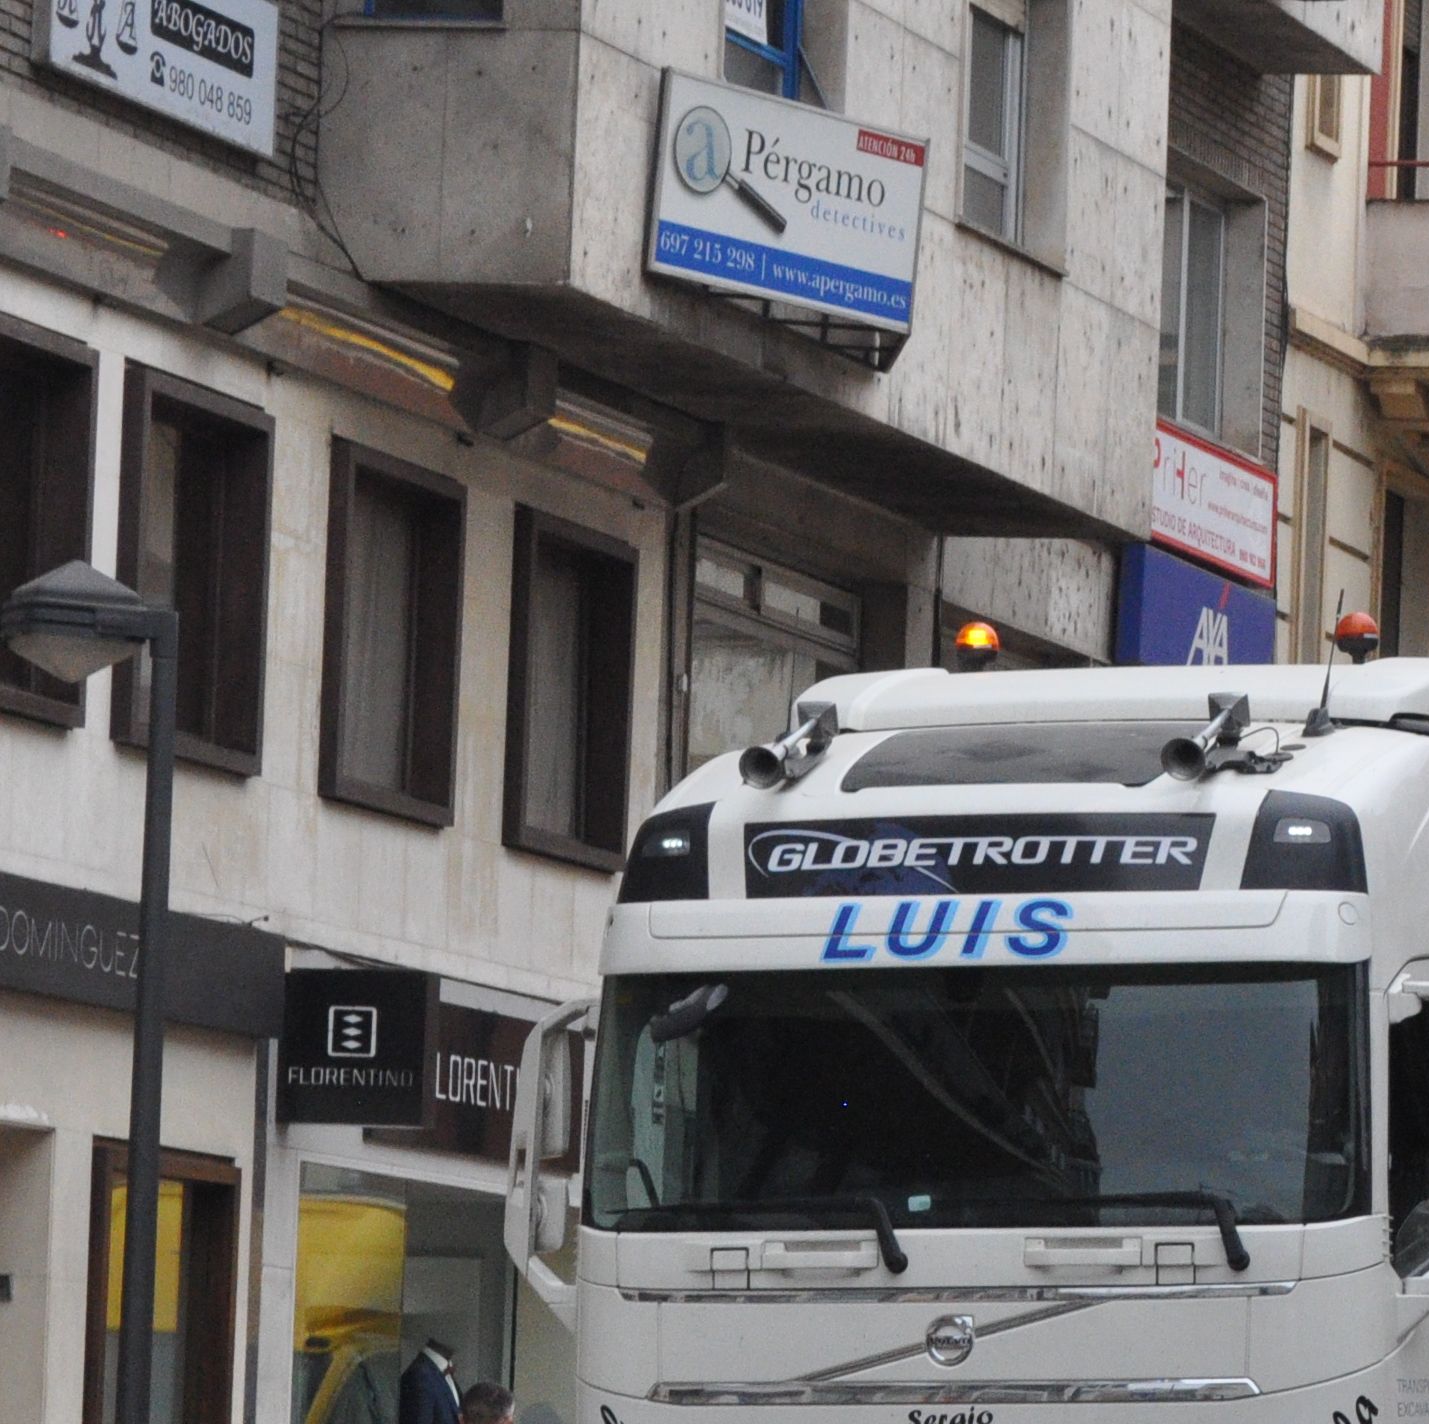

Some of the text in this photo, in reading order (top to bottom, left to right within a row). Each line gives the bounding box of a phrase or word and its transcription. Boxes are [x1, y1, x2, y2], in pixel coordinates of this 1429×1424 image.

[153, 2, 252, 64] ABOGADOS
[169, 66, 251, 125] 980 048 859
[742, 128, 885, 208] Pérgamo
[859, 135, 898, 158] ATENCIÓN
[811, 200, 905, 241] detectives
[660, 231, 906, 309] 697 215 298 www.apergamo.es
[1152, 506, 1176, 531] STUDIO
[767, 834, 1198, 873] GLOBETROTTER
[822, 896, 1075, 964] LUIS
[288, 1066, 414, 1087] FLORENTINO
[435, 1052, 521, 1111] LORENT
